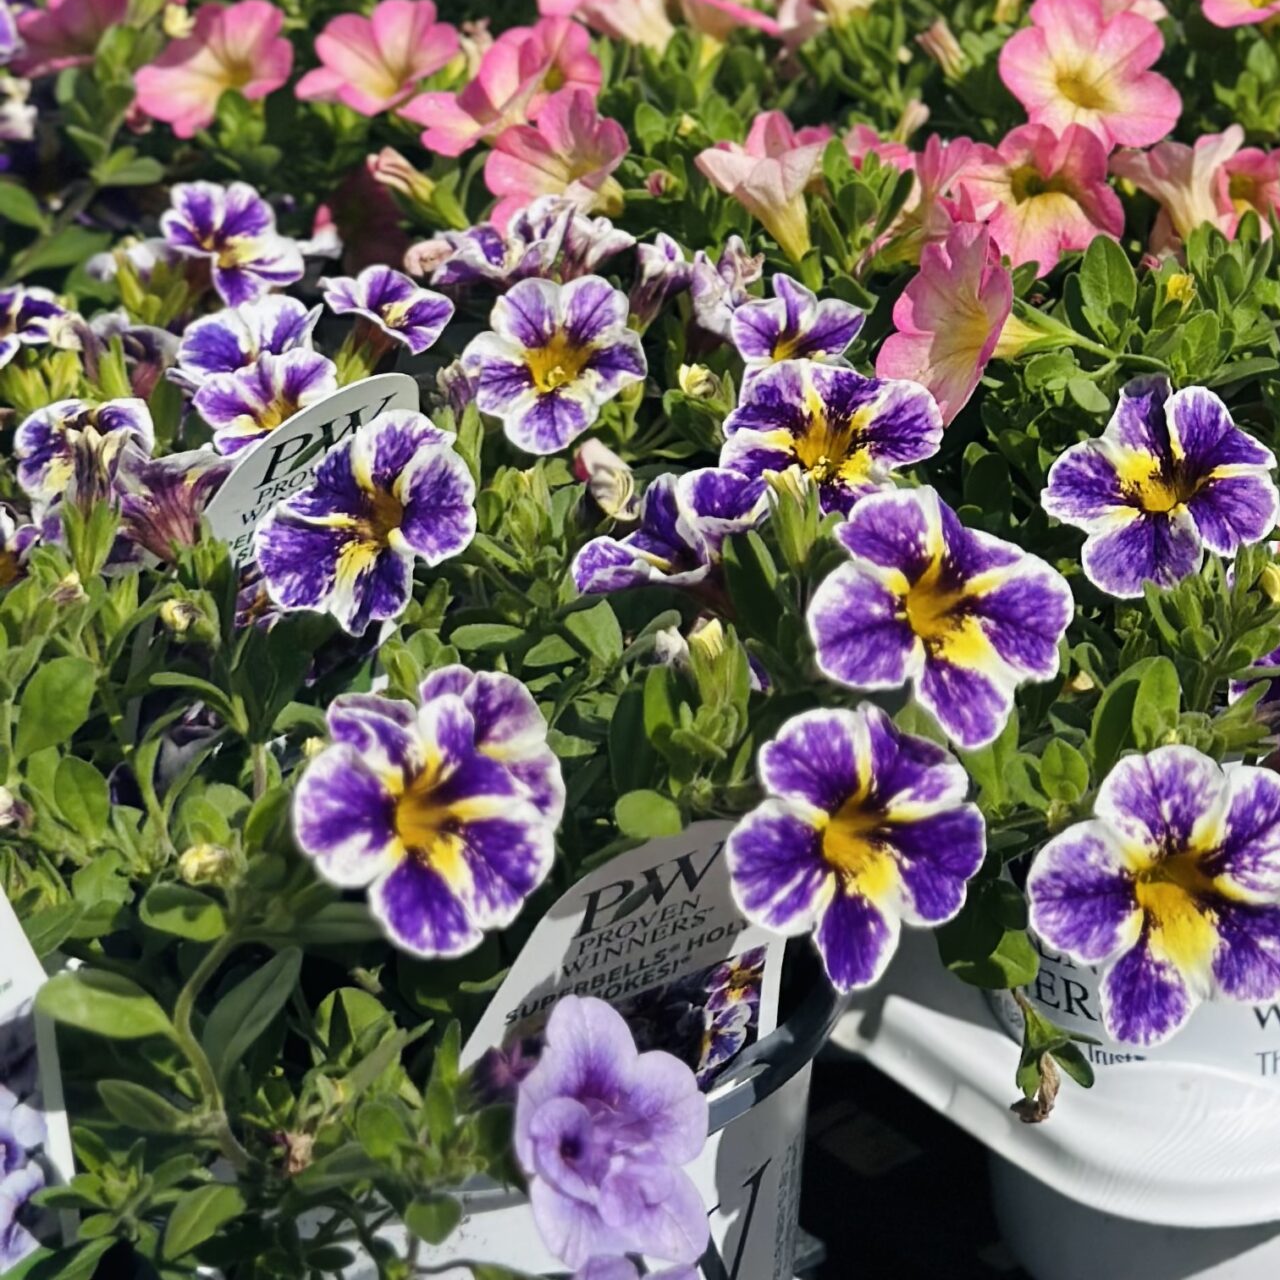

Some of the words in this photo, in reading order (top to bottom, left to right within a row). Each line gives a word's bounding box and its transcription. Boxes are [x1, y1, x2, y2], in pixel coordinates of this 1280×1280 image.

[573, 840, 727, 940] PW
[561, 908, 710, 978] WINNERS
[578, 894, 701, 957] PROVEN
